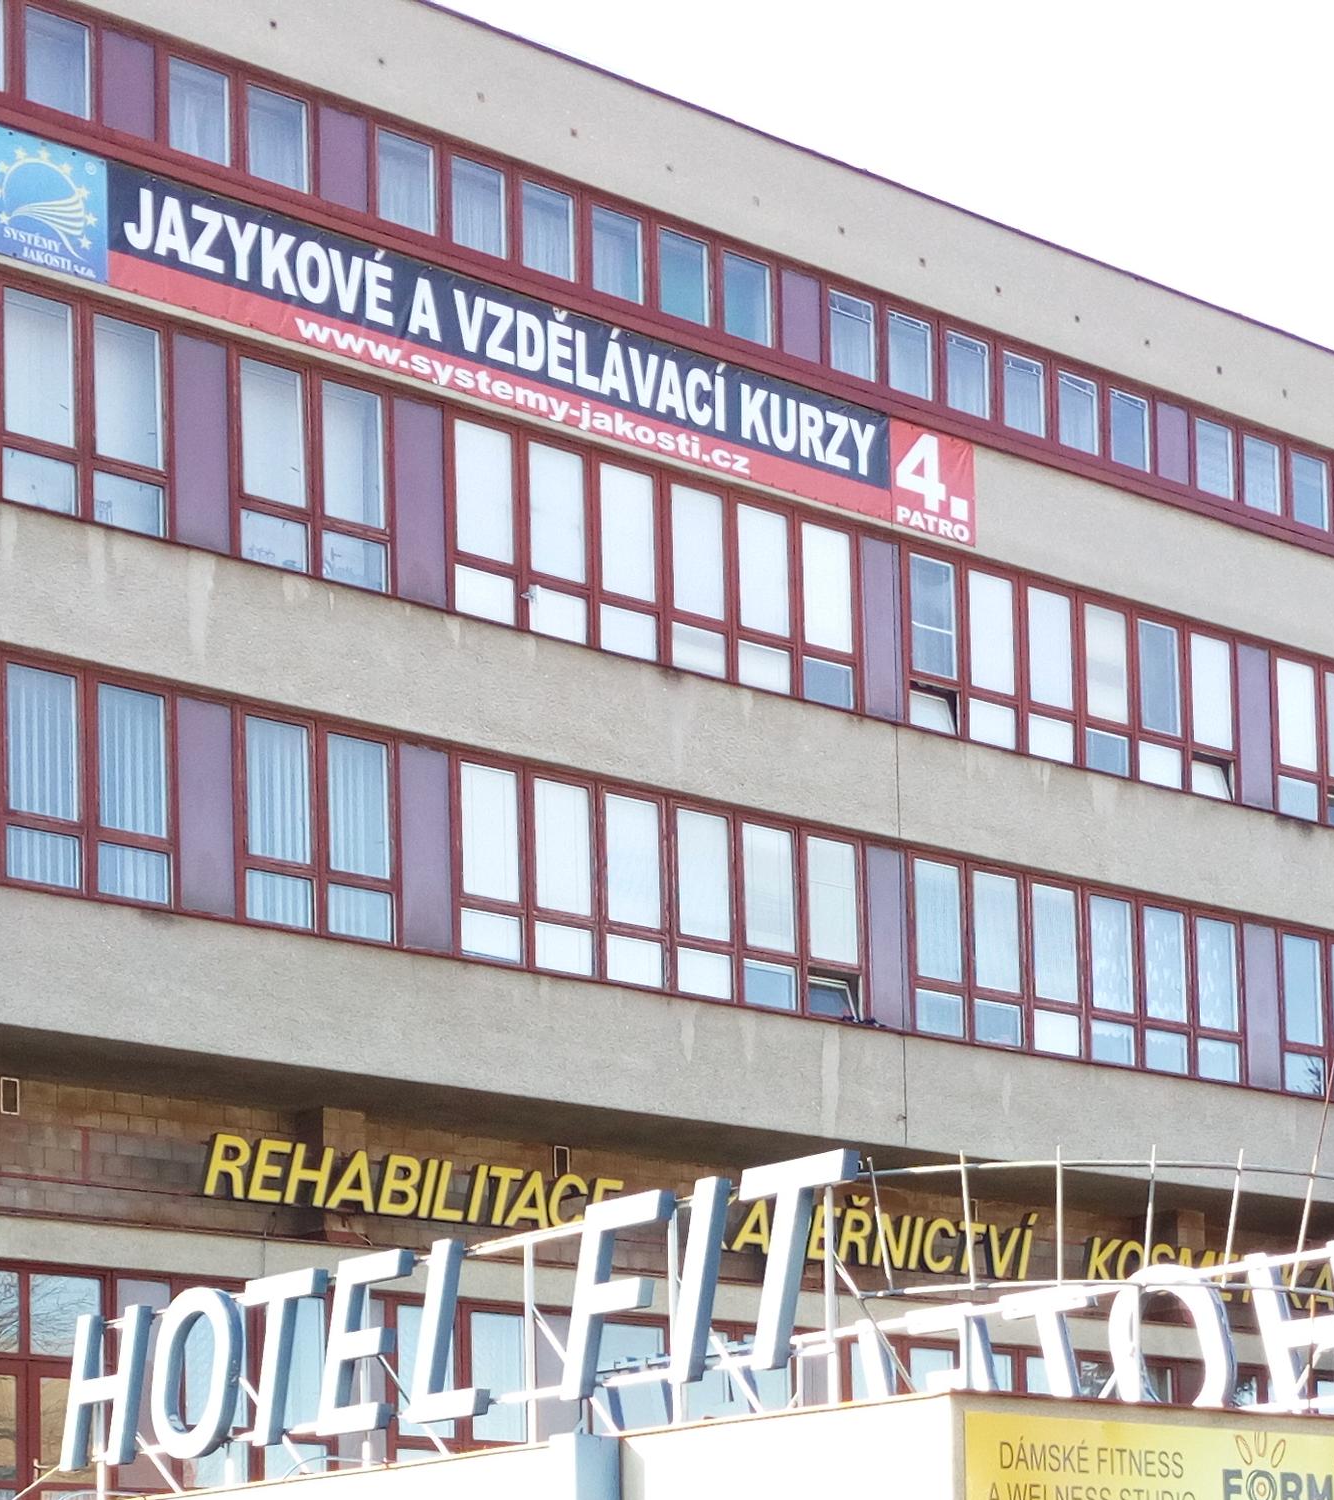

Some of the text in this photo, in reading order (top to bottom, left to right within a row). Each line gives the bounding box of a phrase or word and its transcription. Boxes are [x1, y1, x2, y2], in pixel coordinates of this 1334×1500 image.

[2, 225, 62, 253] SYSTÉMY
[123, 187, 876, 477] JAZYKOVÉ A VZDĚLÁVACÍ KURZY
[295, 316, 751, 477] www.systemy-jakosti.cz
[895, 433, 969, 522] 4.
[896, 504, 970, 543] PATRO
[721, 1191, 1037, 1282] AEŘNICTVÍ
[59, 1148, 860, 1472] HOTEL FIT
[998, 1436, 1185, 1479] DÁMSKÉ FITNESS
